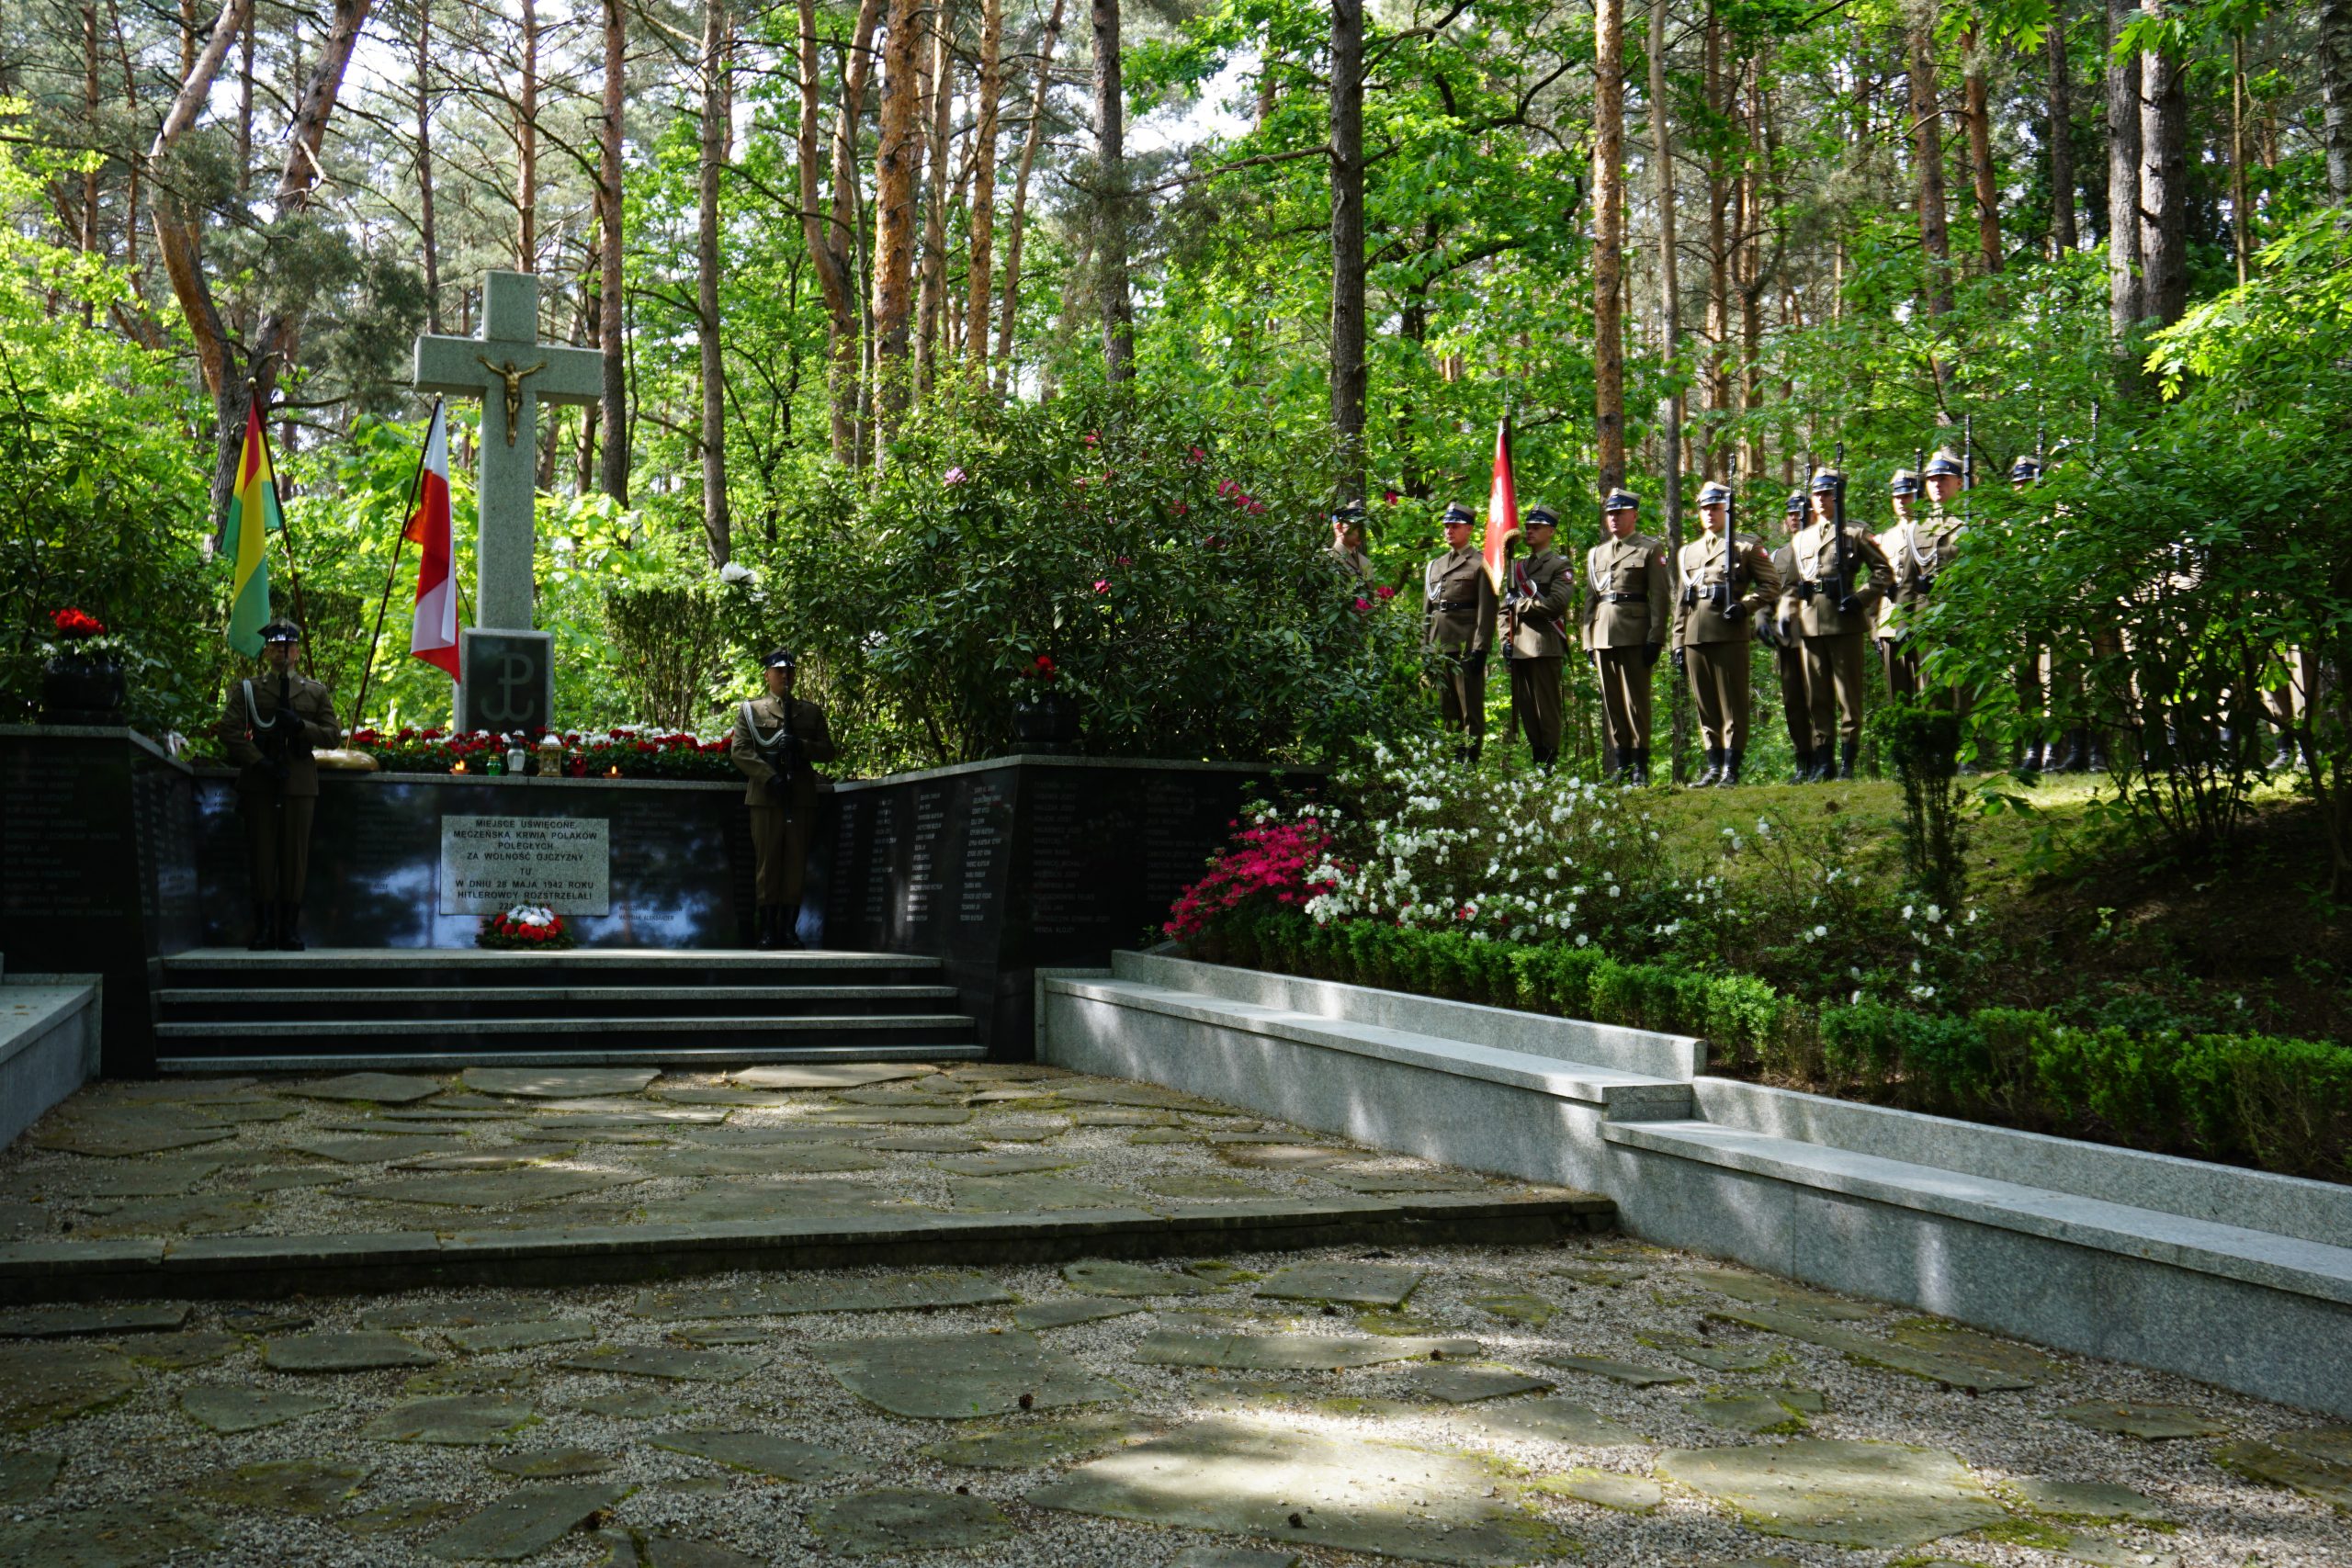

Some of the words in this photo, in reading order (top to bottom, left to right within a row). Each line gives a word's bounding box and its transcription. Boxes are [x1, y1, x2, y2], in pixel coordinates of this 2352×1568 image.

[476, 819, 515, 829] MIEJSCE
[516, 831, 547, 841] KRWIĄ
[551, 830, 597, 840] POLAKÓW
[498, 842, 554, 851] POLEGŁYCH
[484, 852, 531, 862] WOLNOŚĆ
[536, 853, 583, 862] OJCZYZNY
[524, 891, 592, 899] ROZSTRZELALI
